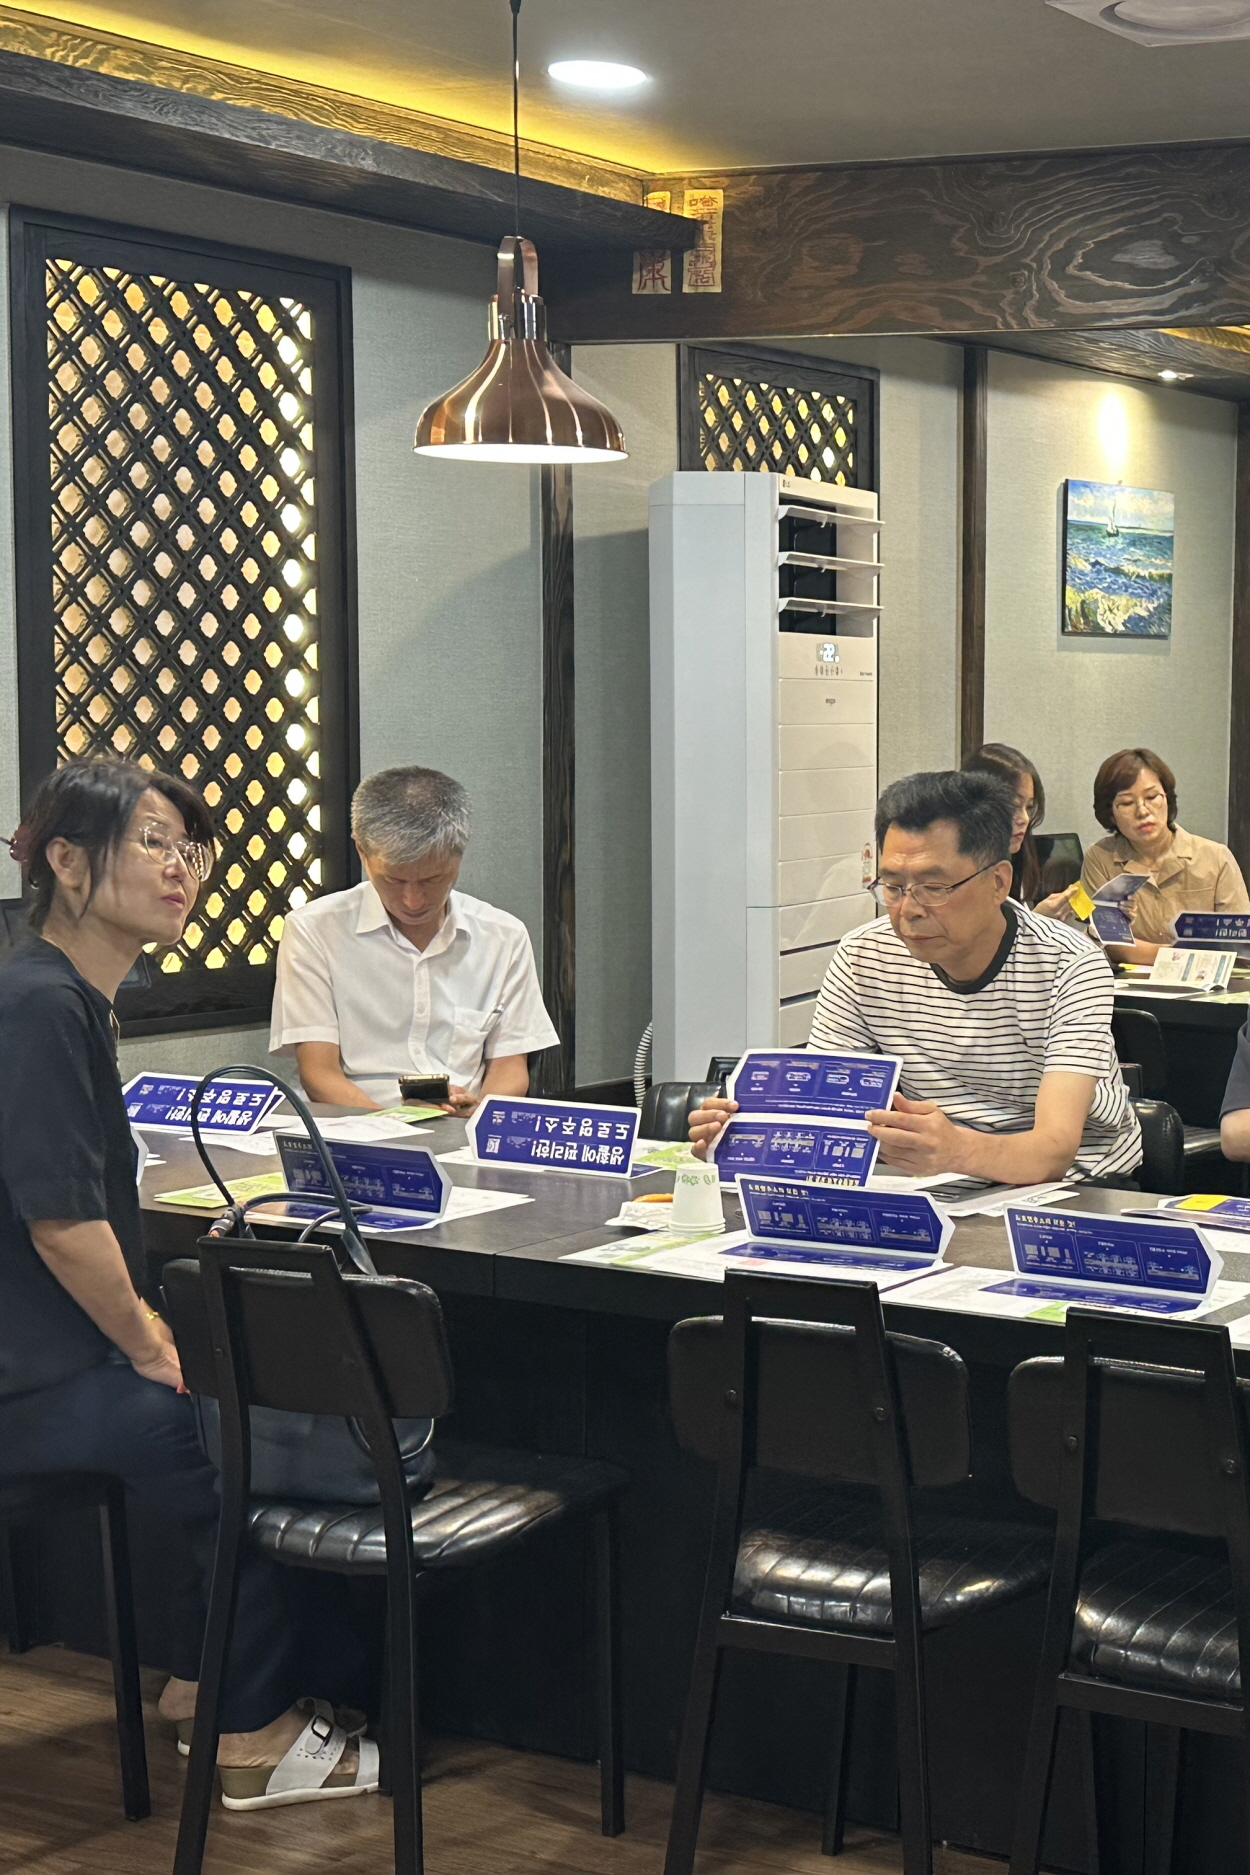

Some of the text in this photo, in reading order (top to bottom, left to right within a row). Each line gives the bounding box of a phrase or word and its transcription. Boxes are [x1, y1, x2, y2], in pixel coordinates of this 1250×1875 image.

[210, 1109, 253, 1126] 생활에
[530, 1139, 625, 1166] 생활에 편리한!
